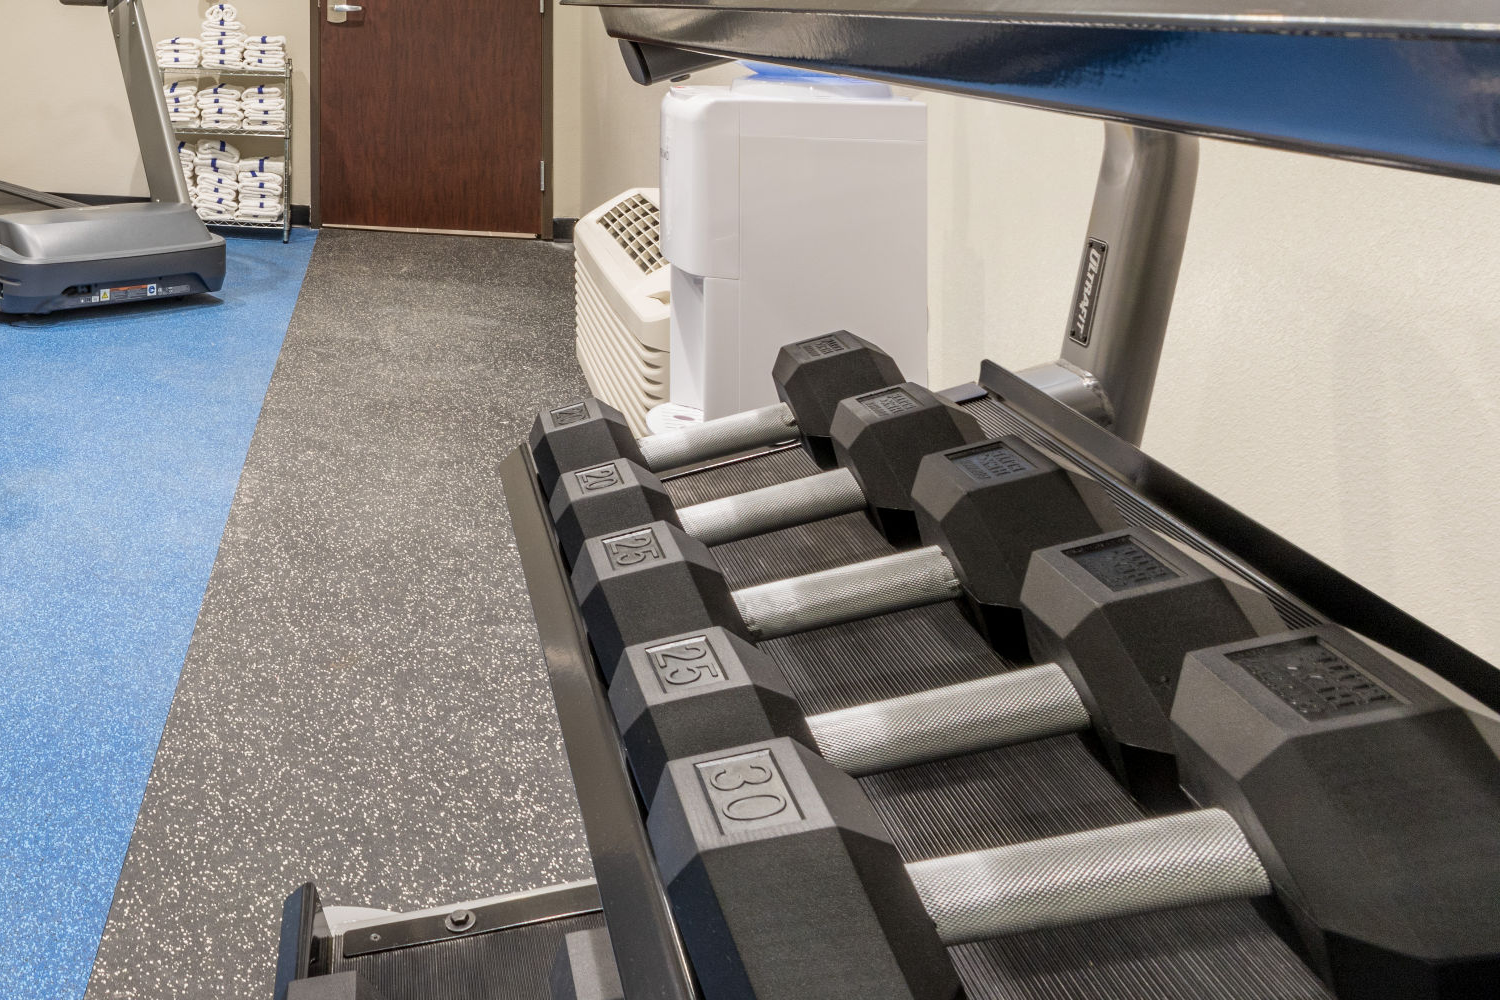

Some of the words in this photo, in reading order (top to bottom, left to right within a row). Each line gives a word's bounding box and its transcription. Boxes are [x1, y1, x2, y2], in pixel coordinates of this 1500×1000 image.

[1076, 247, 1101, 337] ULTRAFIT
[581, 469, 618, 491] 20
[610, 535, 660, 566] 25
[654, 645, 719, 686] 25
[709, 765, 787, 821] 30
